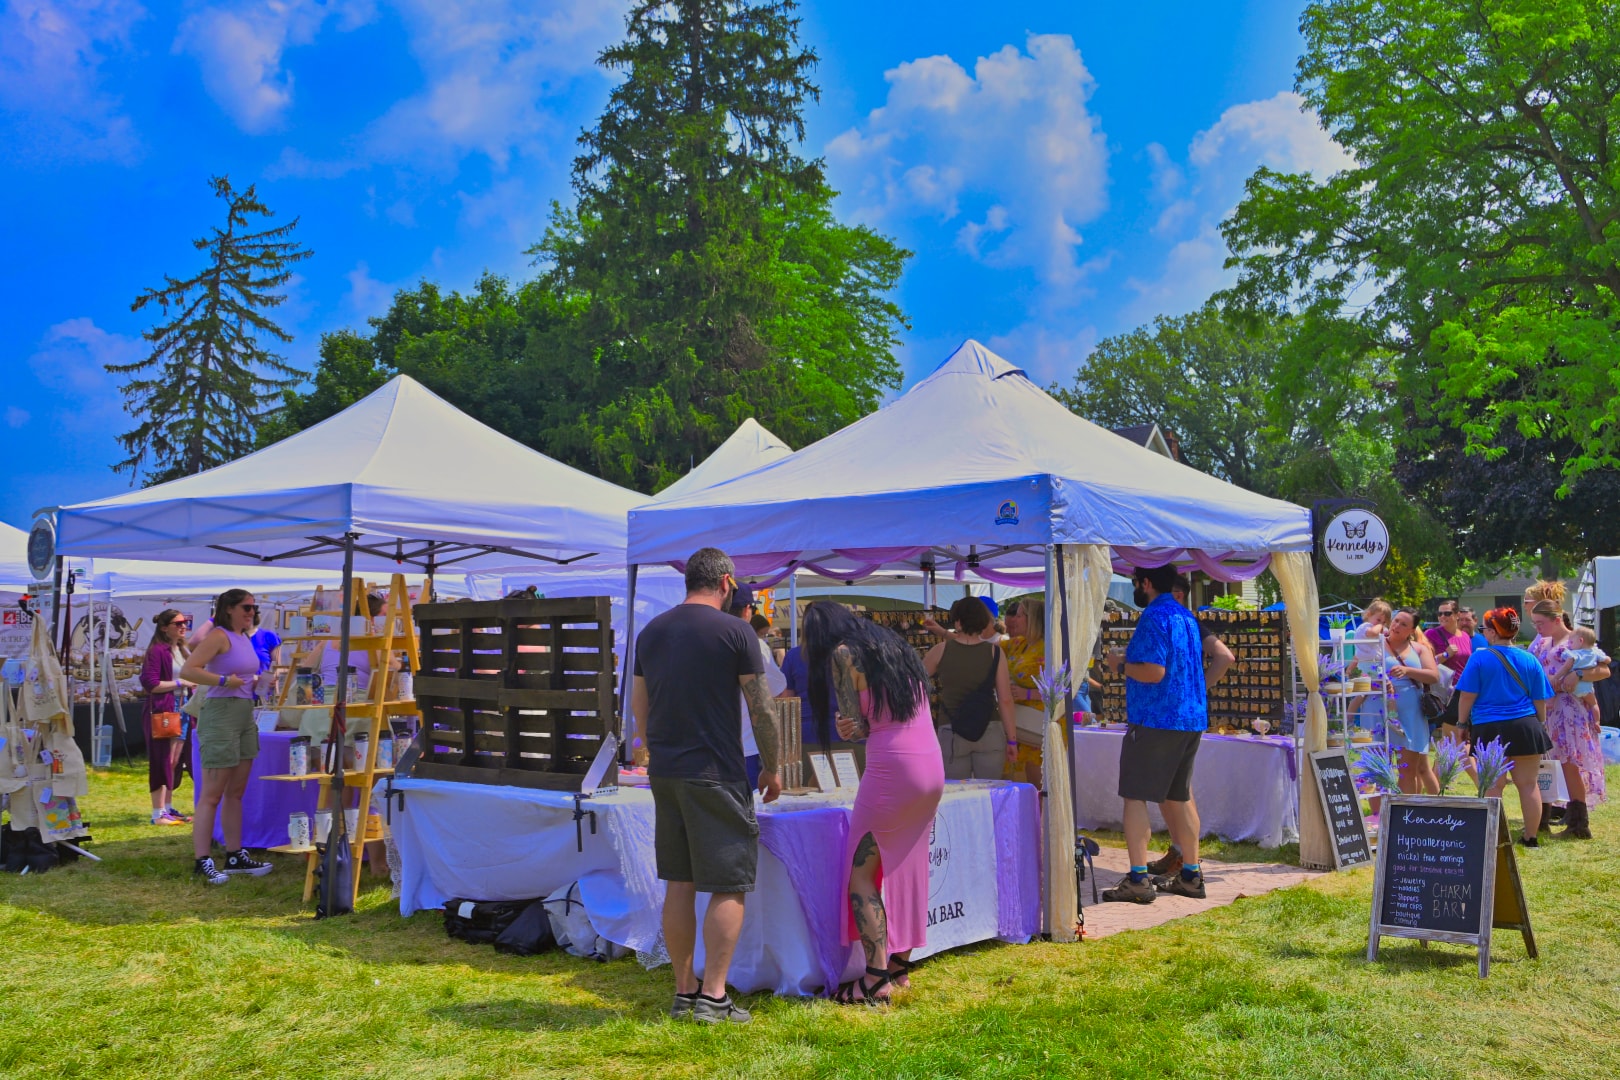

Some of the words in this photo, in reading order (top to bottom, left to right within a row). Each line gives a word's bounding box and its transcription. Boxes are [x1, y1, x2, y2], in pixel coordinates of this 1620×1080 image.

[1327, 538, 1384, 554] Kennedy's
[1403, 809, 1466, 831] Kennedys
[1397, 834, 1466, 852] Hypoallergenic
[1432, 882, 1472, 901] CHARM
[940, 901, 965, 922] BAR
